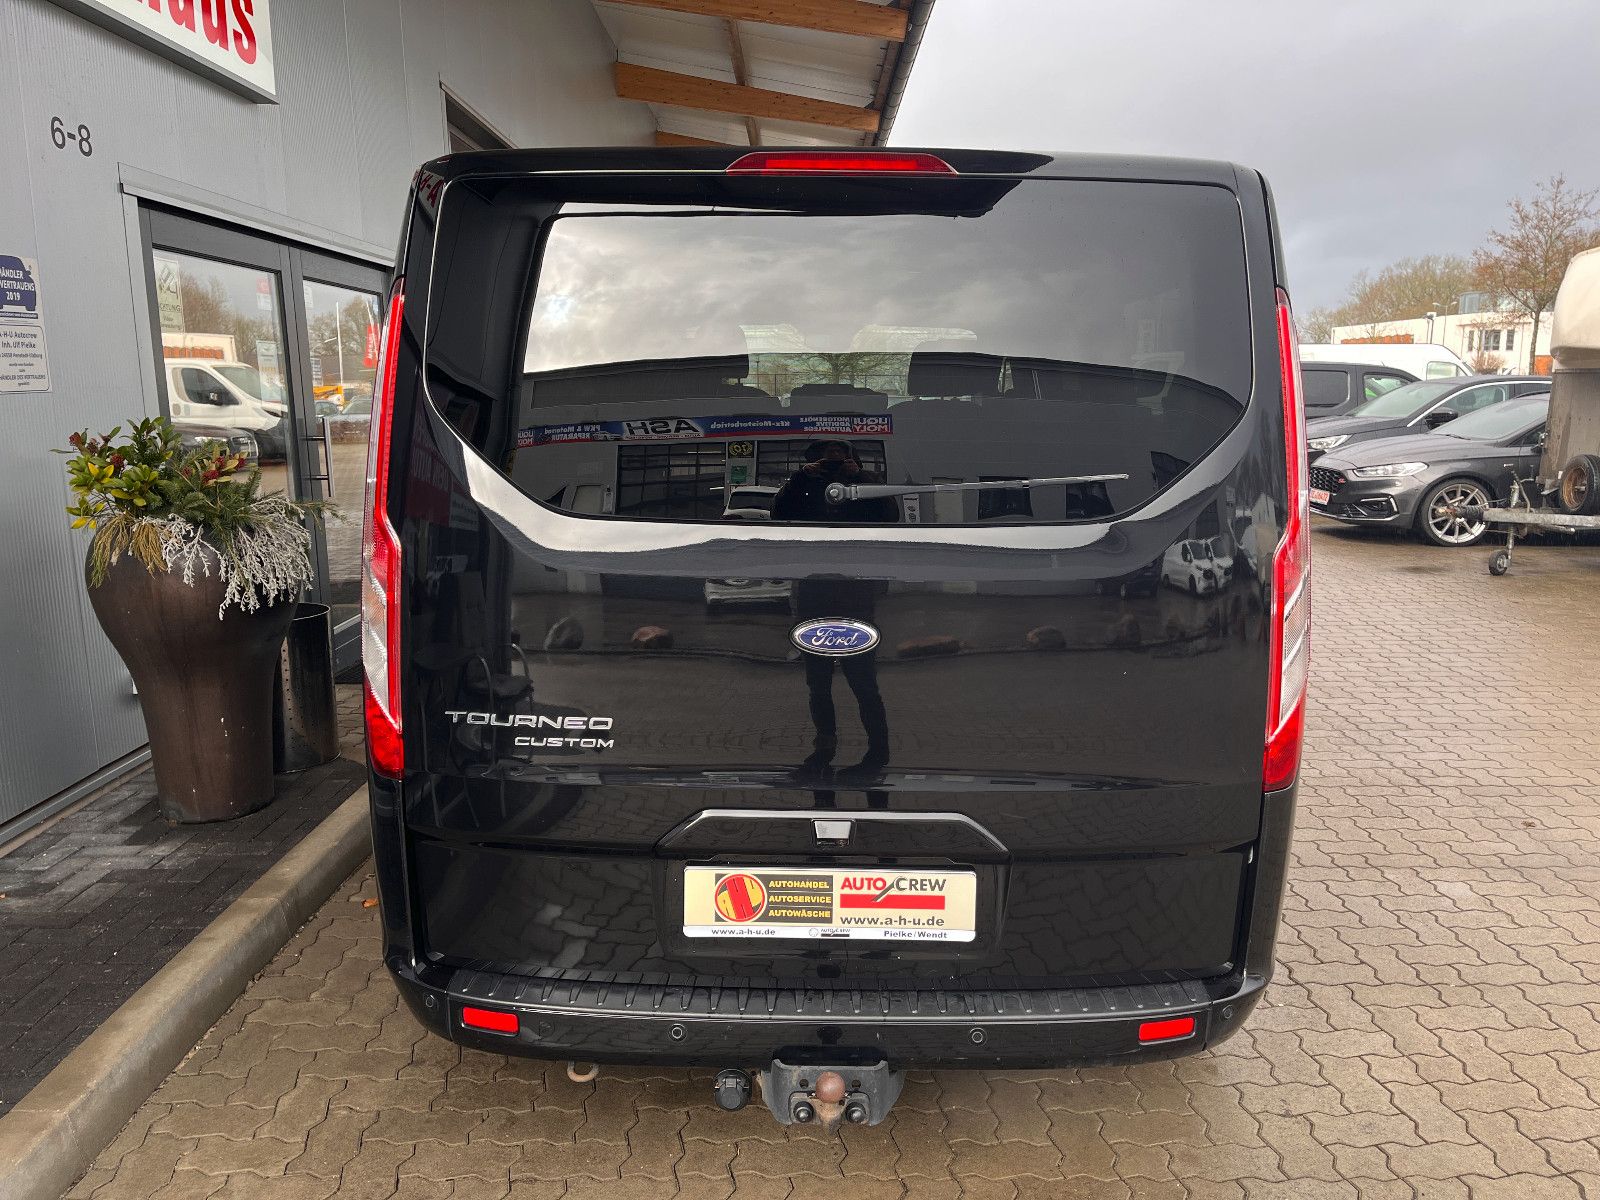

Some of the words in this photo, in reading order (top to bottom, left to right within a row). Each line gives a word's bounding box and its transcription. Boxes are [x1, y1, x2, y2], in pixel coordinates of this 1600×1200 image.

[50, 116, 93, 157] 6-8
[0, 267, 24, 279] ÄNDLER
[6, 291, 21, 301] 2019
[811, 627, 859, 646] Ford
[444, 710, 614, 730] TOURNEO
[514, 736, 615, 749] CUSTOM
[768, 880, 830, 889] AUTOHANDEL
[840, 877, 887, 891] AUTO
[894, 876, 947, 892] CREW
[768, 895, 832, 904] AUTOSERVICE
[768, 909, 831, 918] AUTOWÄSCHE
[840, 915, 945, 927] www.a-h-u.de
[711, 928, 776, 936] www.a-h-u.de
